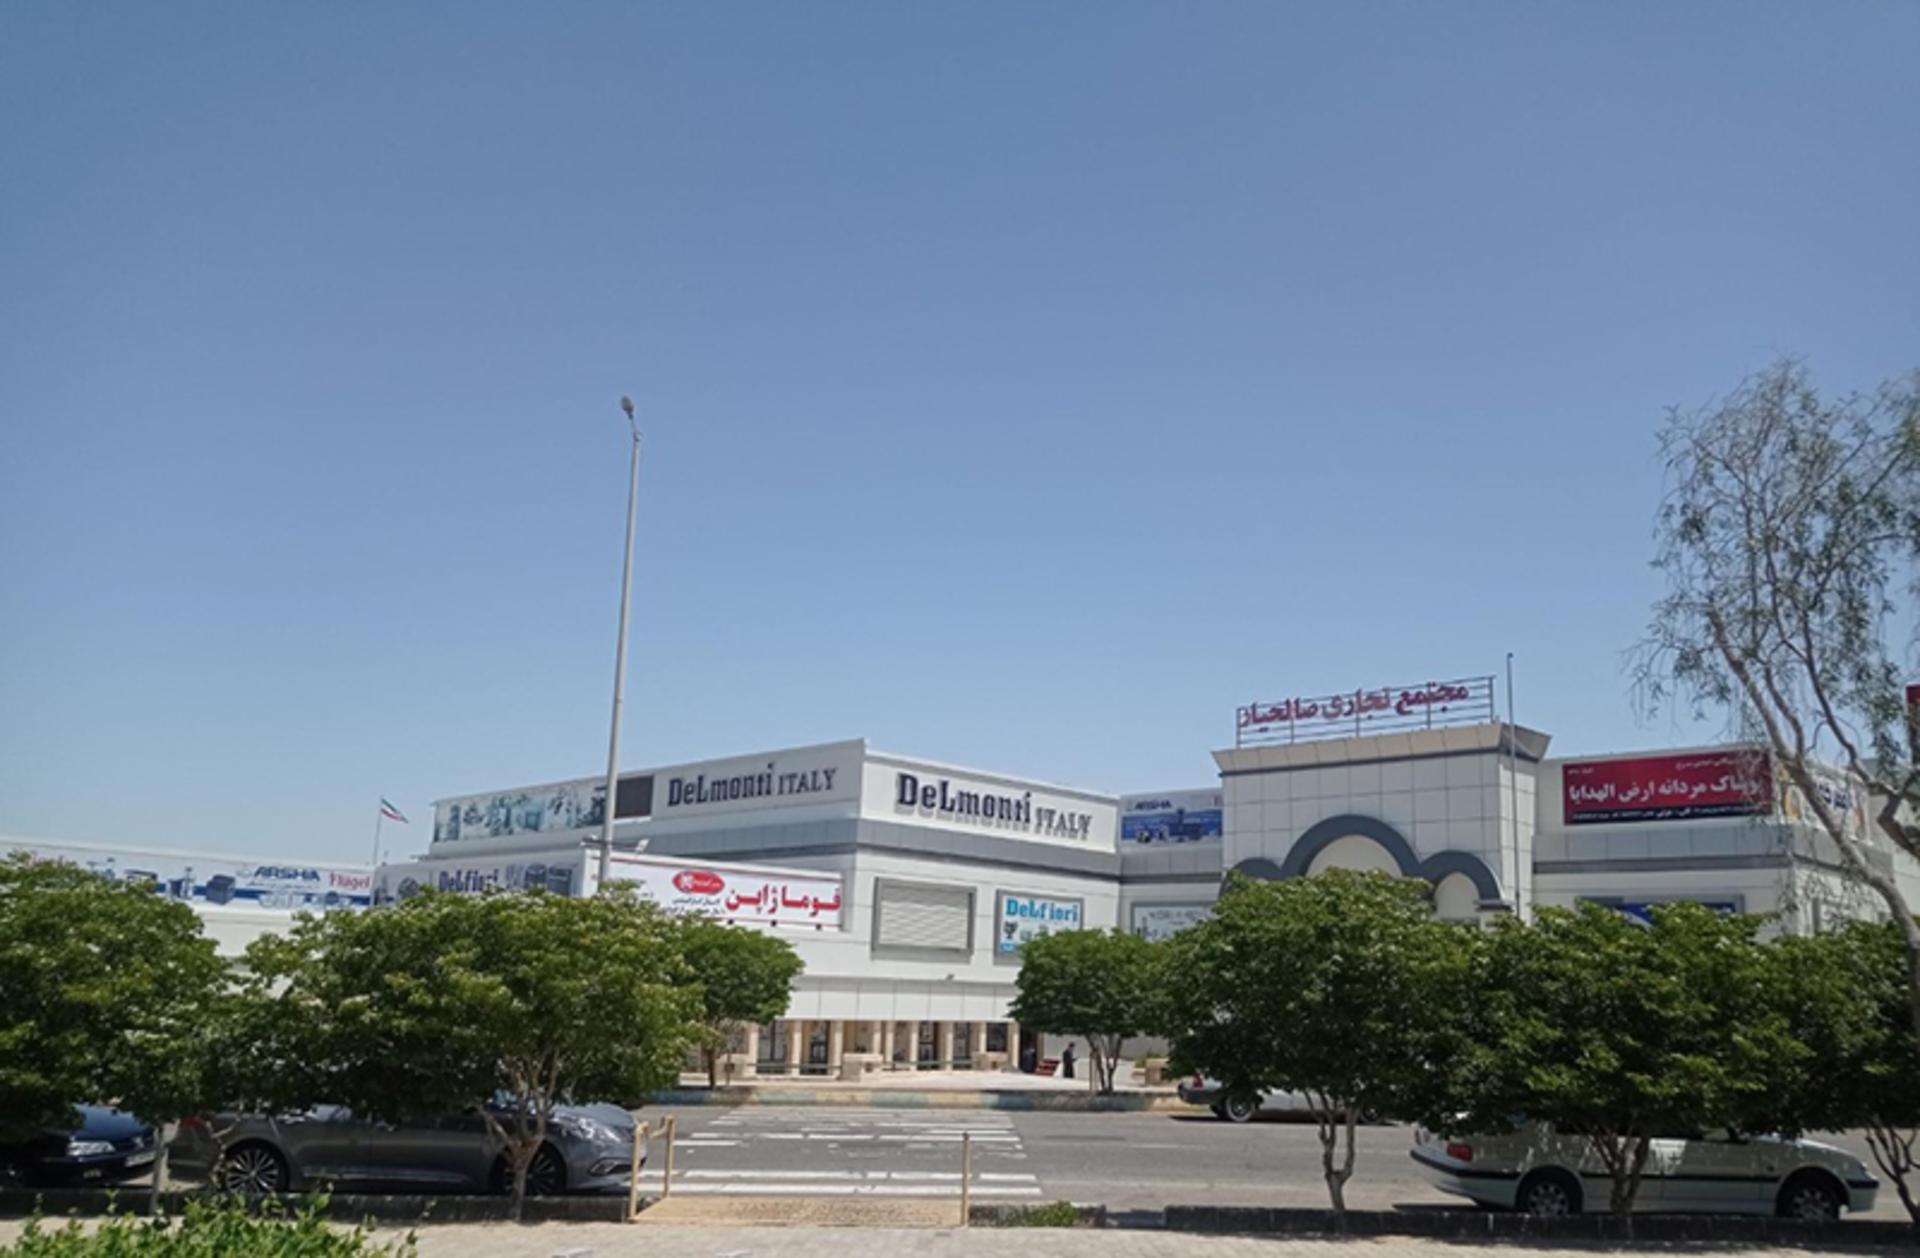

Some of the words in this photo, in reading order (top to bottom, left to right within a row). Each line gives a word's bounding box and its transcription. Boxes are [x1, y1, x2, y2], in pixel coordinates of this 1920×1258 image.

[1394, 682, 1469, 715] مجتمع
[778, 766, 838, 795] ITALY
[1659, 778, 1707, 799] مردانه
[1034, 805, 1093, 836] ITALY
